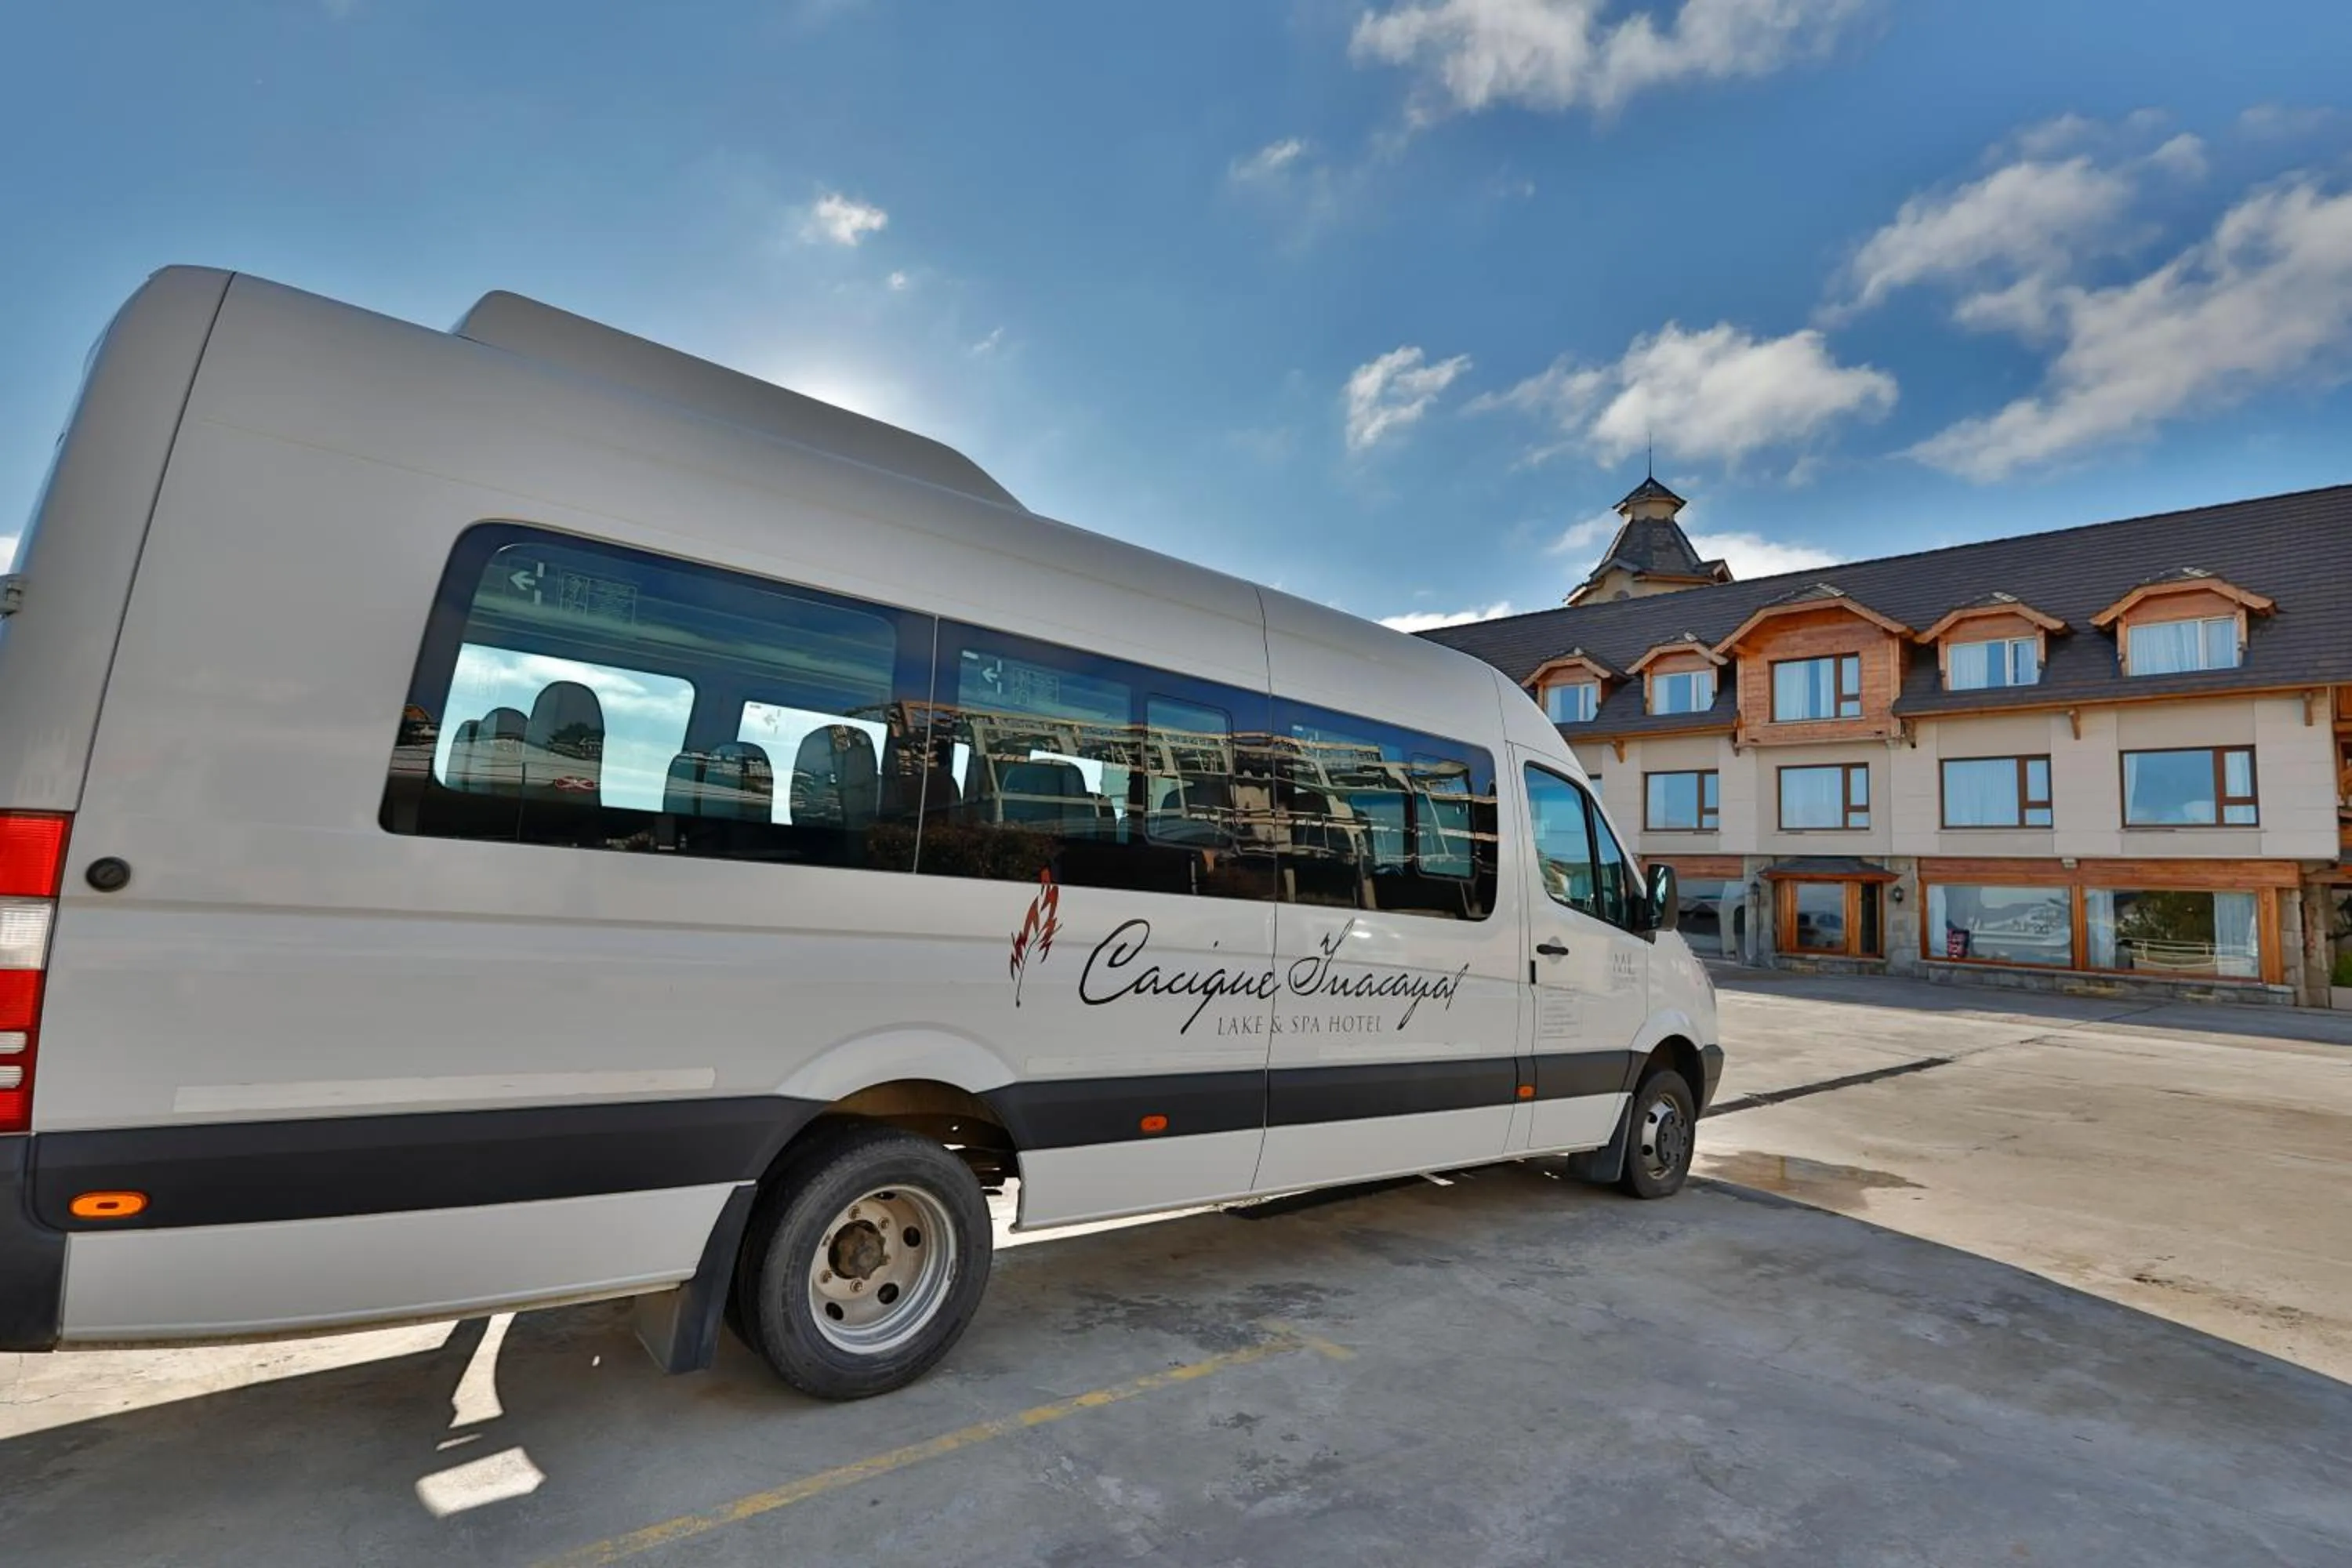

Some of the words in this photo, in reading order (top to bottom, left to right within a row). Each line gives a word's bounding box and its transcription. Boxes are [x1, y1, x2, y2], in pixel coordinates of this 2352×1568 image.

[1079, 918, 1281, 1034] Cacique
[1217, 1016, 1265, 1036] LAKE
[1270, 1016, 1283, 1034] &
[1290, 1015, 1320, 1034] SPA
[1329, 1015, 1382, 1033] HOTEL
